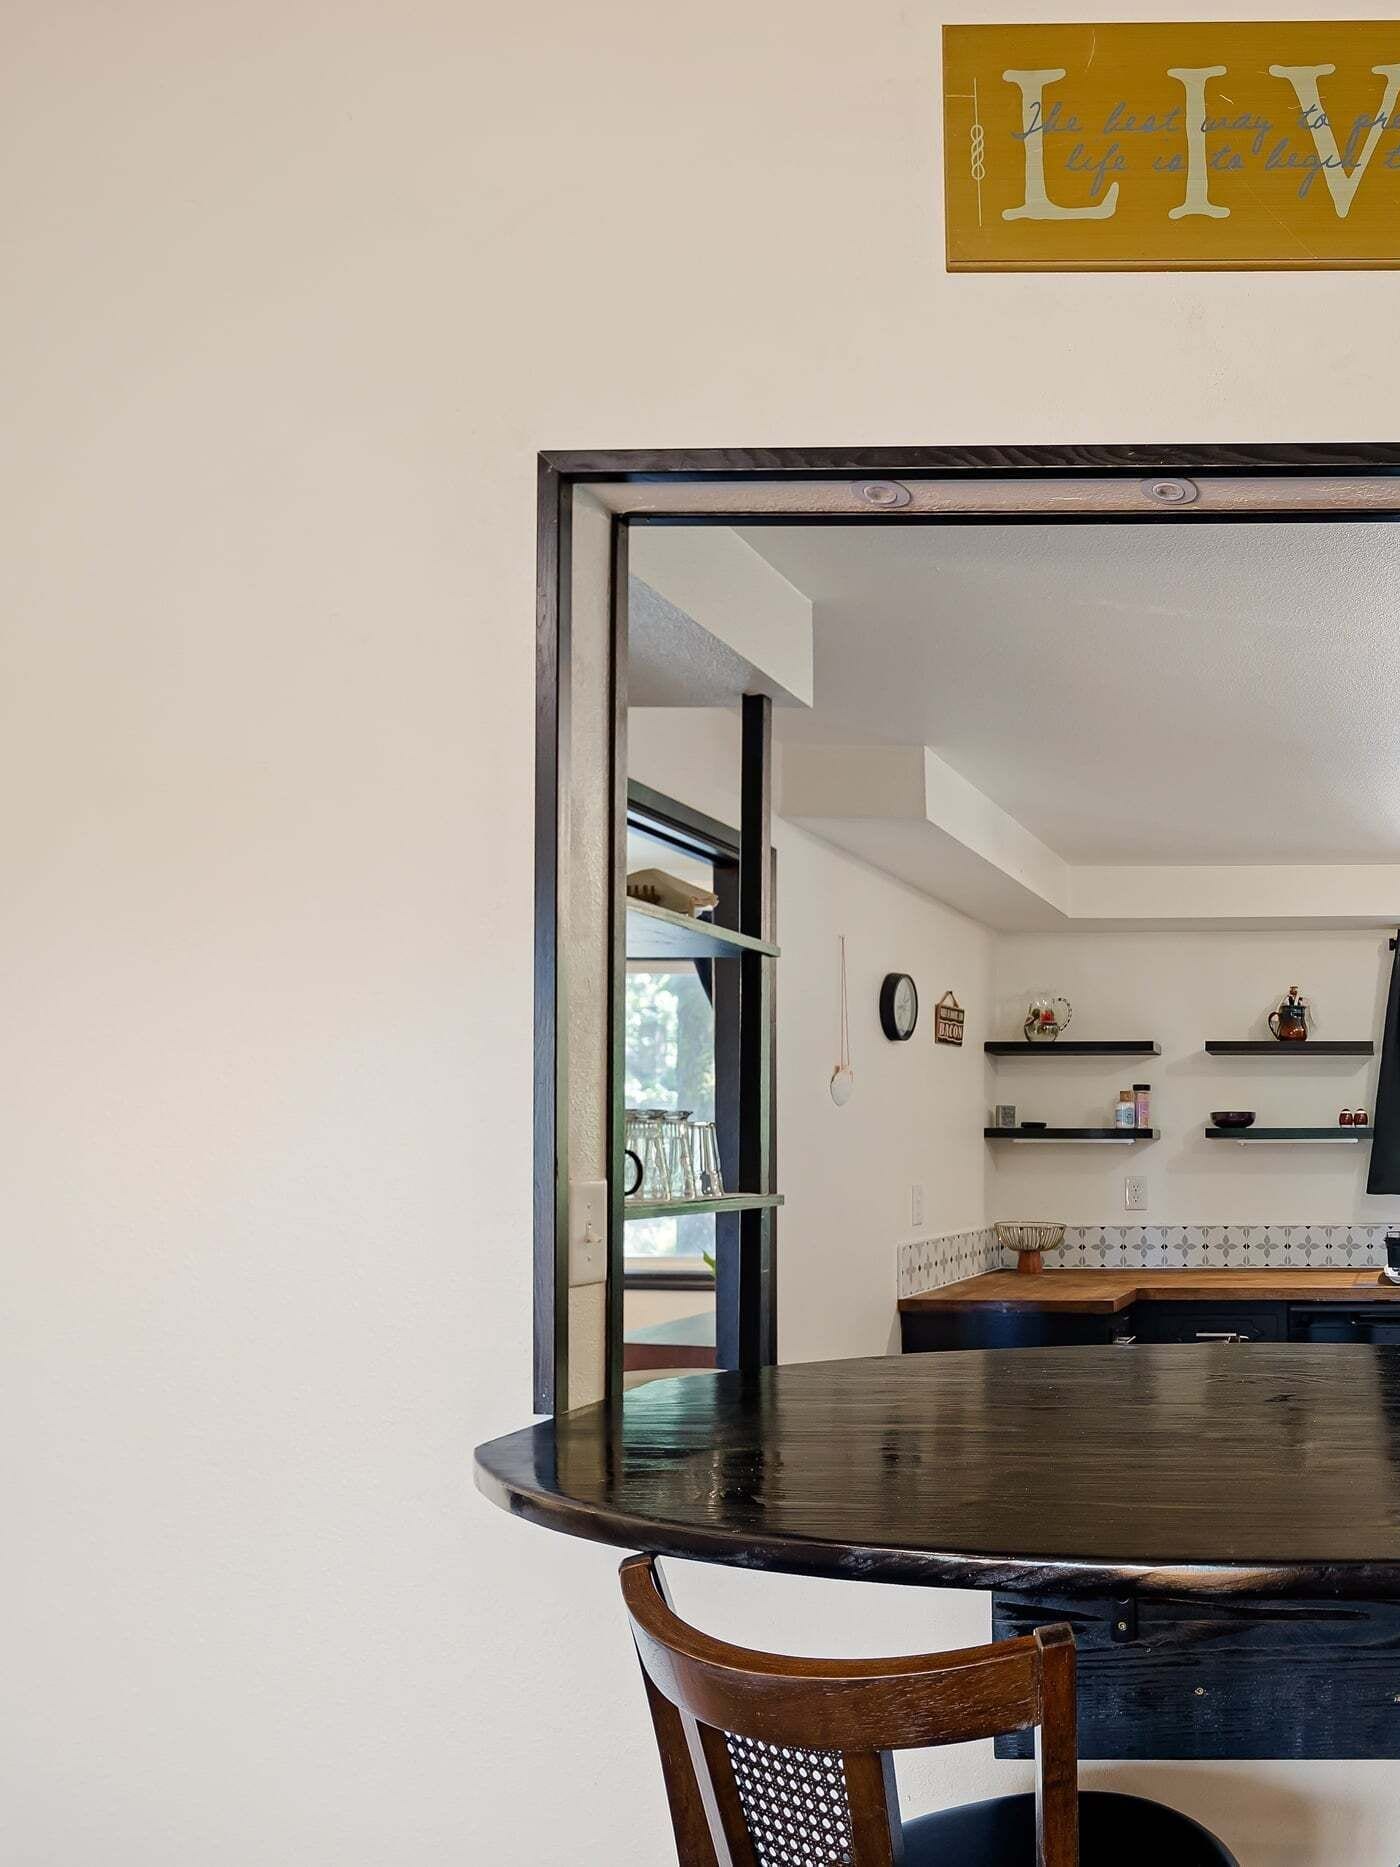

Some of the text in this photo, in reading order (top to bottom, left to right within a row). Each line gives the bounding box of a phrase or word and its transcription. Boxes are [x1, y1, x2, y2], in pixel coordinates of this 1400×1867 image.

[1011, 101, 1083, 140] The
[1103, 101, 1186, 133] best
[1200, 112, 1273, 155] way
[1299, 101, 1330, 130] to
[1064, 142, 1131, 198] life
[1152, 150, 1189, 173] is
[1210, 143, 1246, 172] to
[1264, 138, 1363, 199] begin
[940, 1023, 962, 1039] BACON
